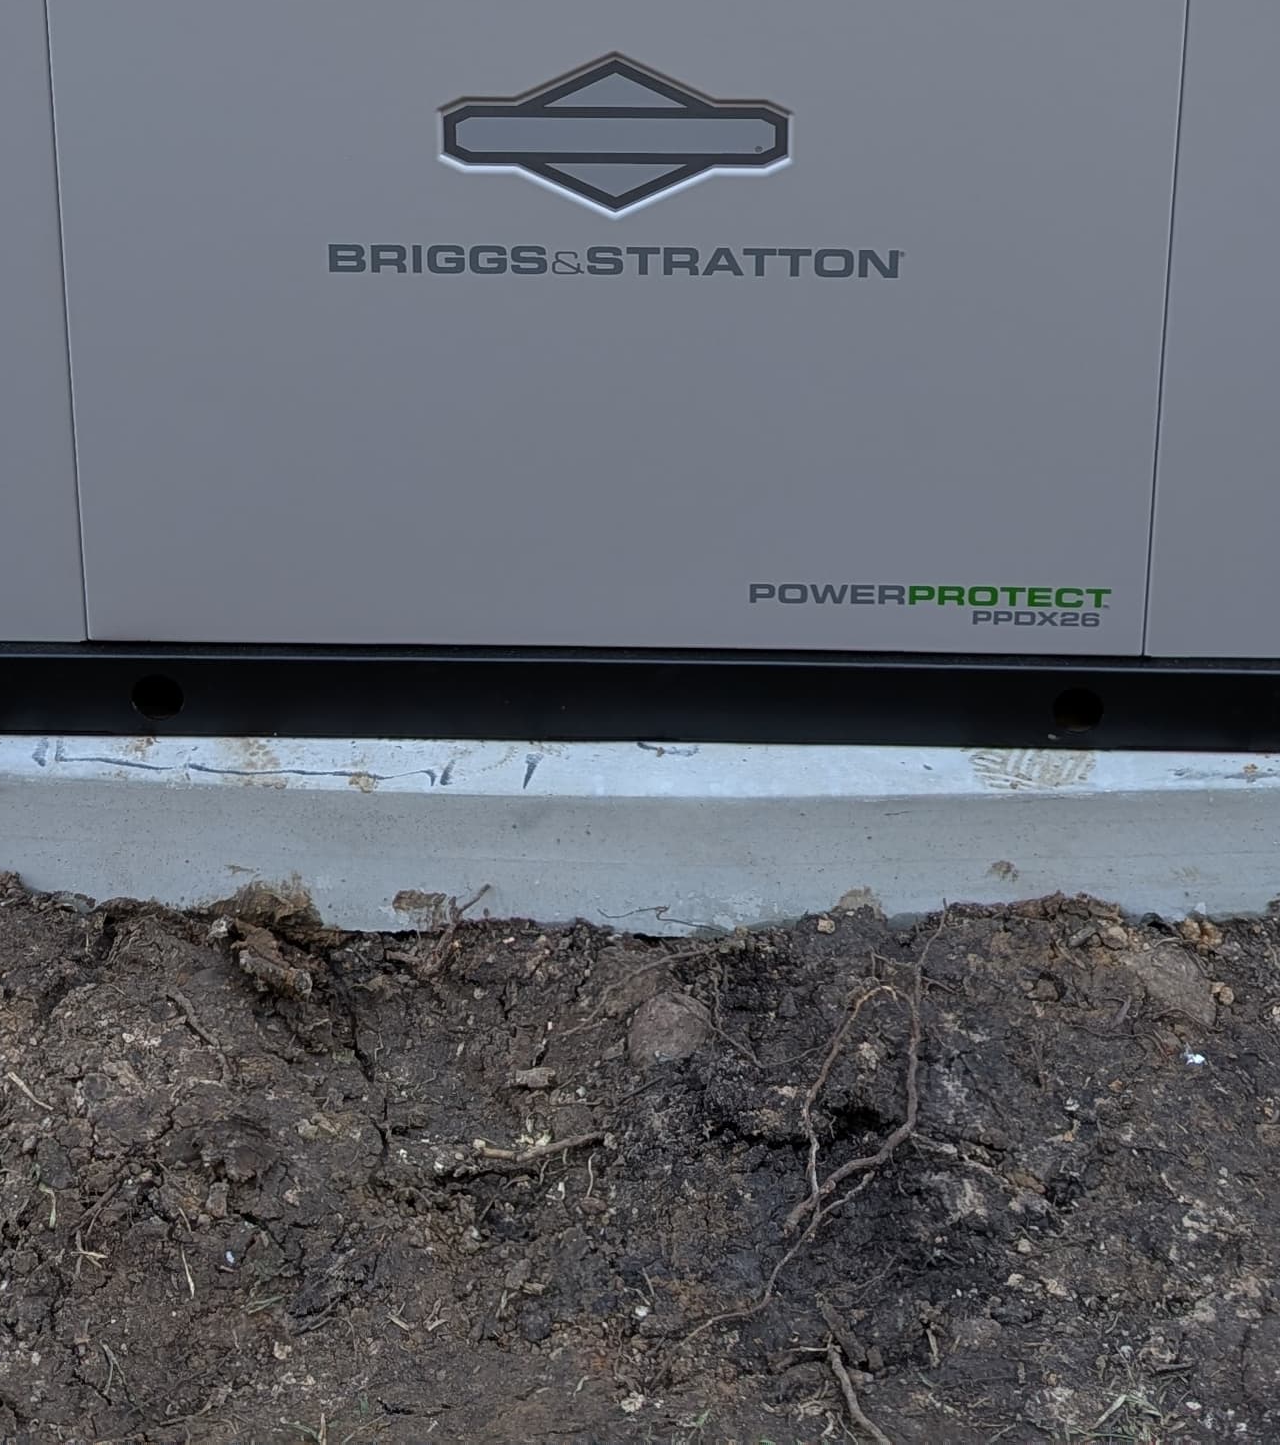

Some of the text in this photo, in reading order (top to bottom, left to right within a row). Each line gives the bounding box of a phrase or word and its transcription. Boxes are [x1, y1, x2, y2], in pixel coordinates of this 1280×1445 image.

[328, 243, 900, 279] BRIGGS&STRATTON
[749, 583, 1112, 609] POWERPROTECT
[972, 610, 1101, 627] PPDX26
